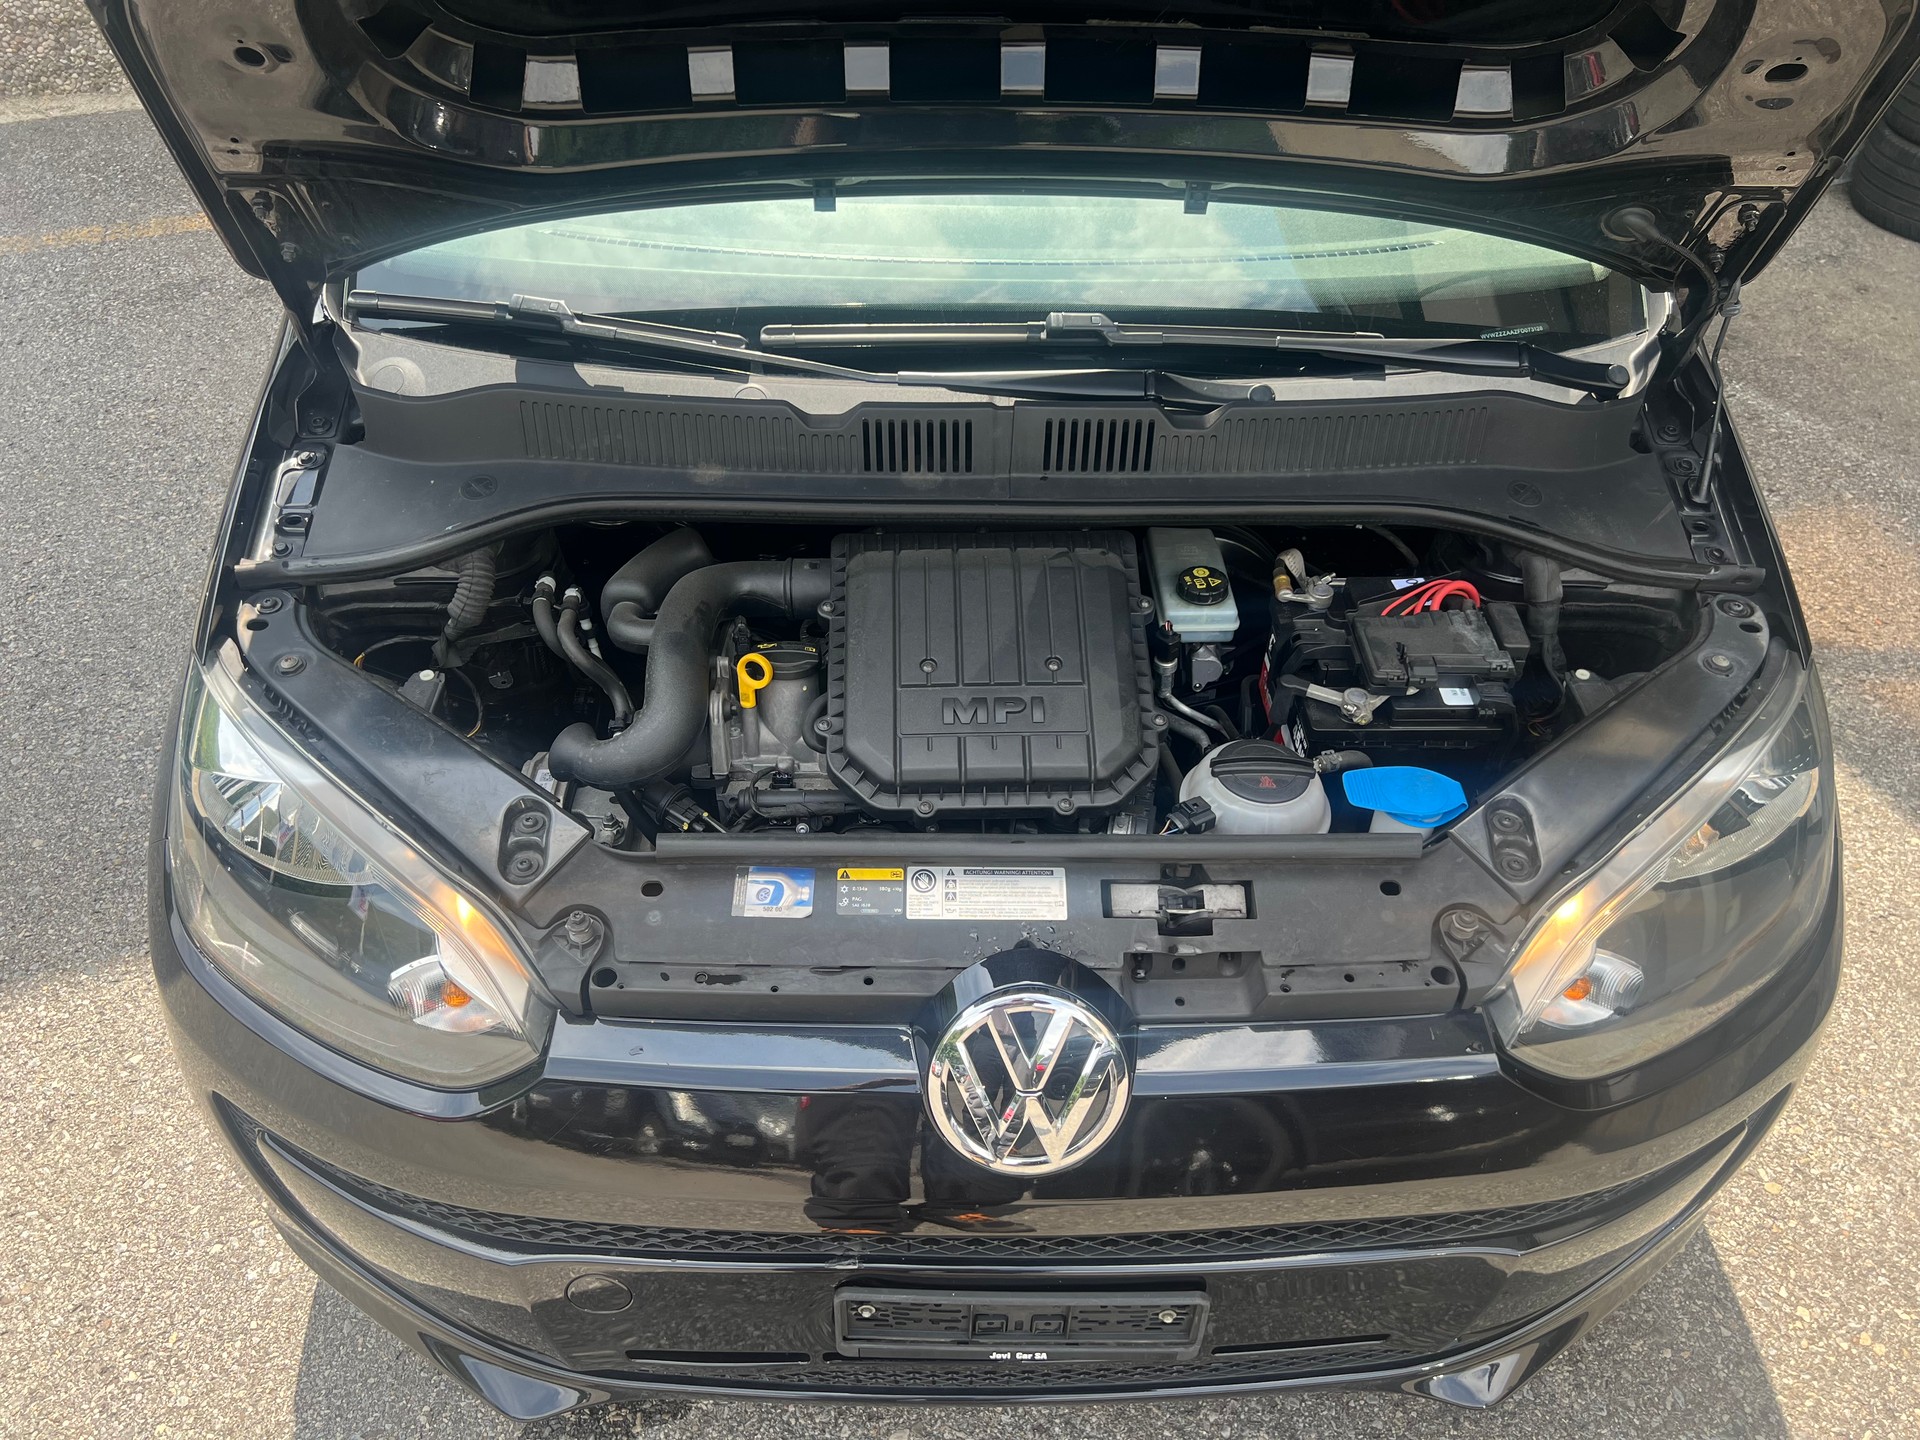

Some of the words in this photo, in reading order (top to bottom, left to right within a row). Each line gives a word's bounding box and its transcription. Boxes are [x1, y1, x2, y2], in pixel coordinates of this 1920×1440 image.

[942, 696, 1045, 725] MPI
[928, 993, 1130, 1175] VW
[1016, 1352, 1033, 1360] Car
[1034, 1352, 1048, 1360] SA
